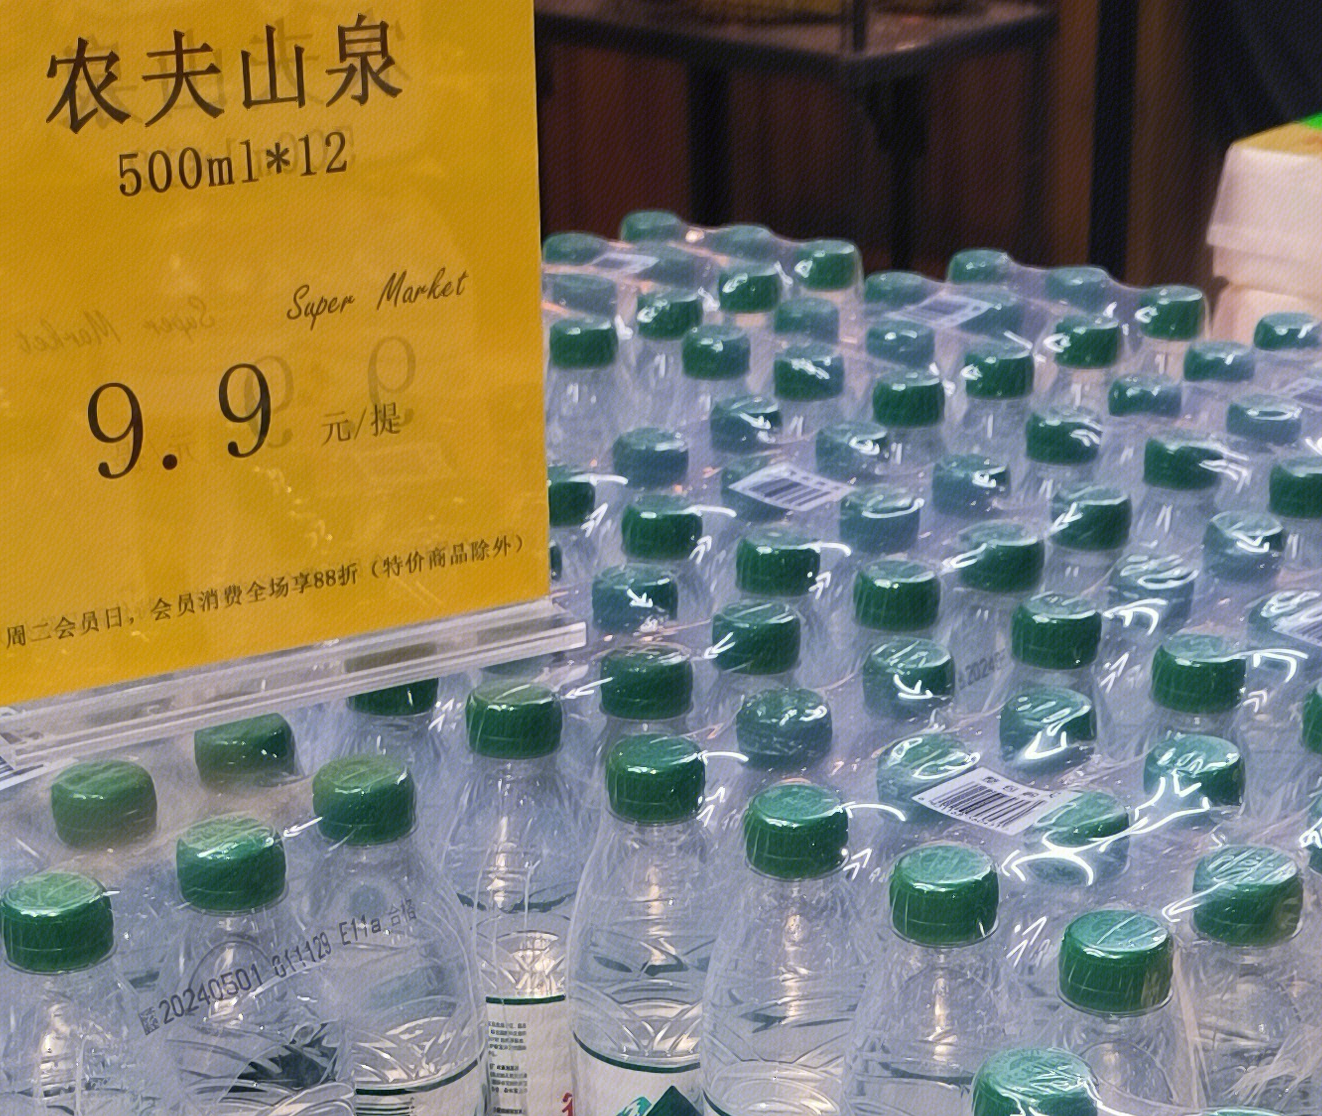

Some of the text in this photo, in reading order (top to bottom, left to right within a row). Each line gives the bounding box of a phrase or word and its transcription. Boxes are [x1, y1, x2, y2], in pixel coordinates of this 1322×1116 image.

[46, 13, 403, 134] 农夫山泉
[287, 267, 469, 331] Super Market
[158, 963, 263, 1025] 20240501
[387, 897, 417, 927] 合格
